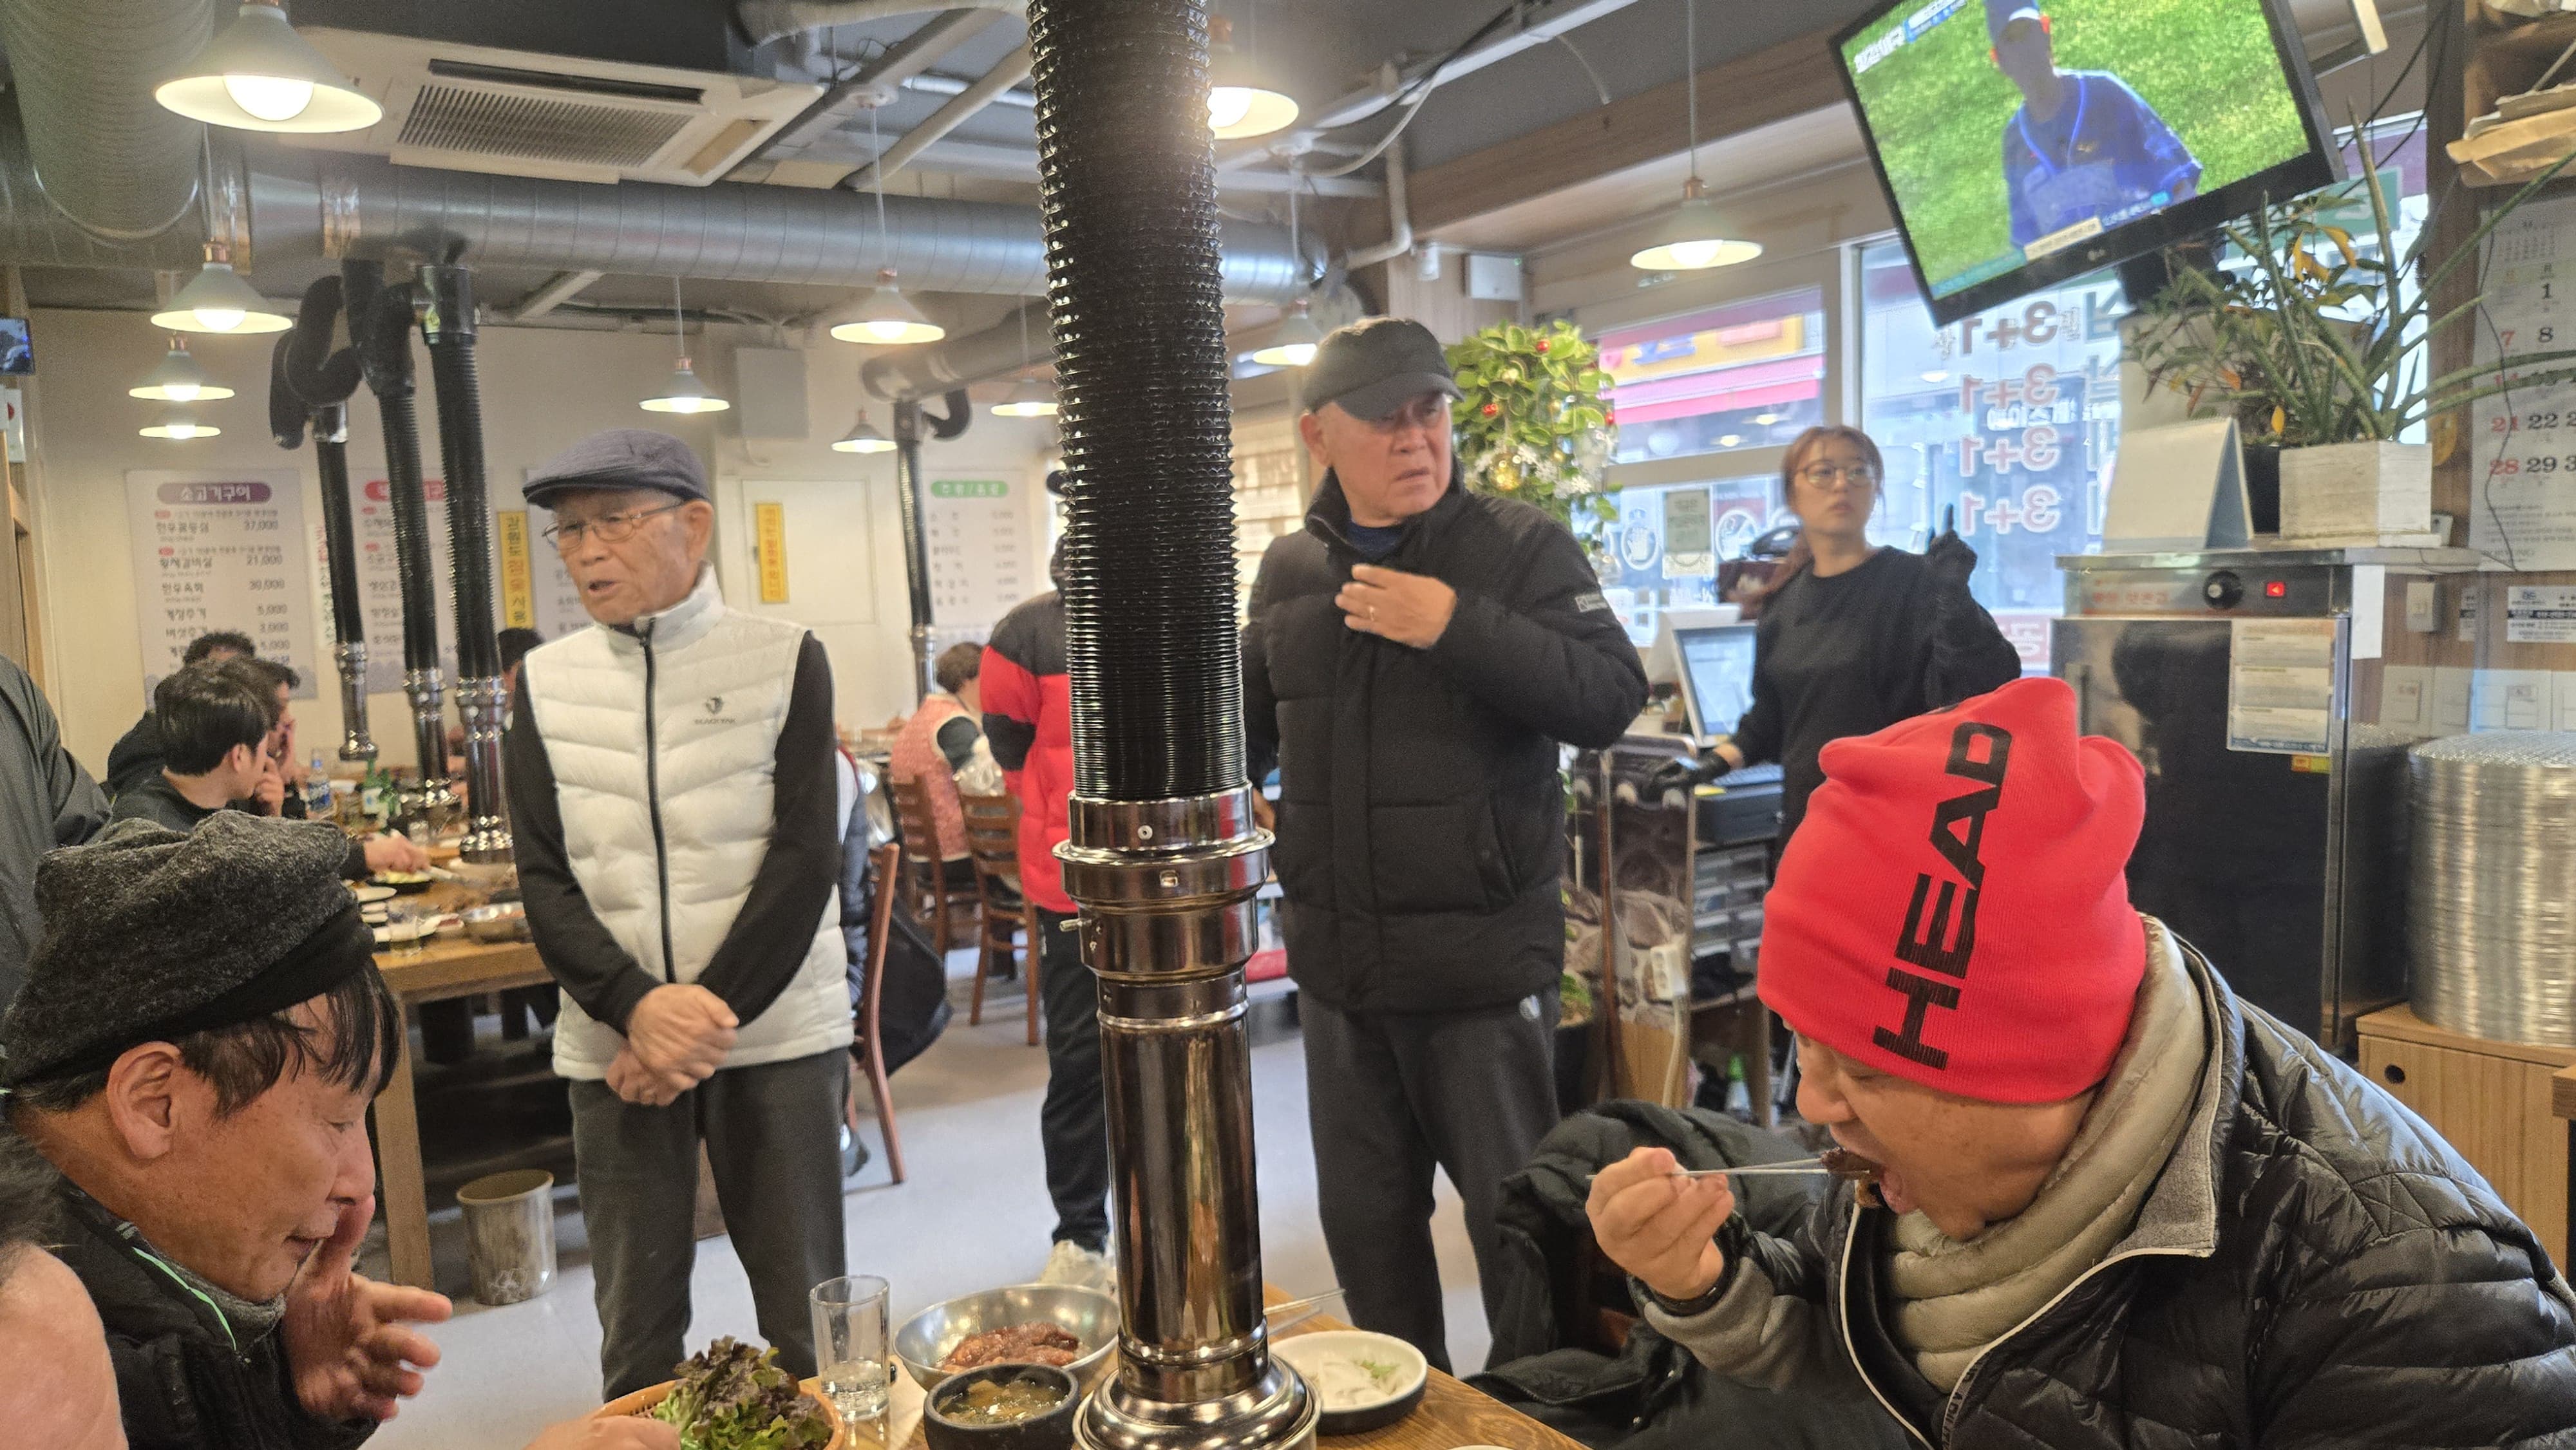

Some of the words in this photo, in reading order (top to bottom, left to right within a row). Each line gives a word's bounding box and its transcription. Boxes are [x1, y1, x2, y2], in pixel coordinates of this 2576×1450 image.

[2542, 283, 2552, 299] 1
[2501, 330, 2515, 346] 7
[2539, 327, 2553, 343] 8
[2492, 416, 2519, 432] 21
[2528, 413, 2559, 429] 22
[2490, 458, 2519, 475] 28
[2526, 457, 2557, 473] 29
[180, 485, 251, 502] 소고기구이
[1873, 721, 2012, 1070] HEAD
